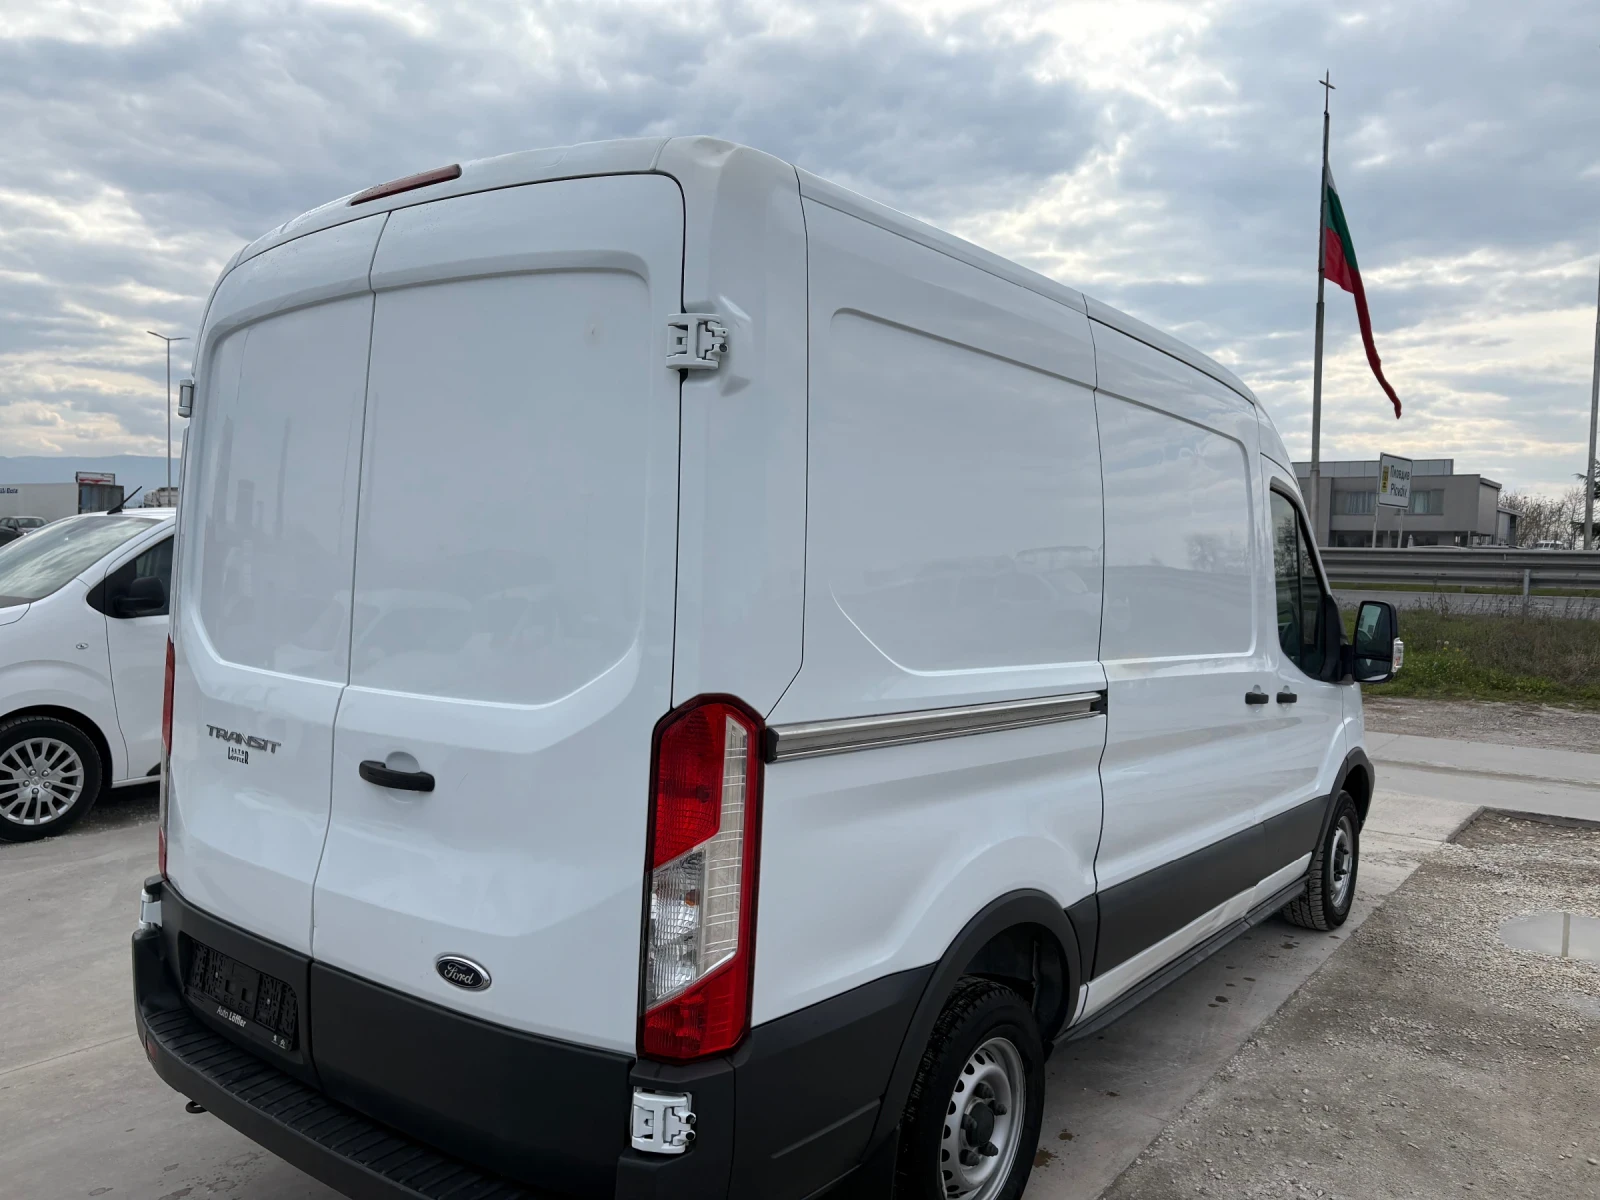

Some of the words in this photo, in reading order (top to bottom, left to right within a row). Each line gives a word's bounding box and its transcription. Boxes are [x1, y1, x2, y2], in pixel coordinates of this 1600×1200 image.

[206, 724, 282, 754] TRANSIT
[444, 962, 475, 985] Ford
[216, 1005, 228, 1018] Auto
